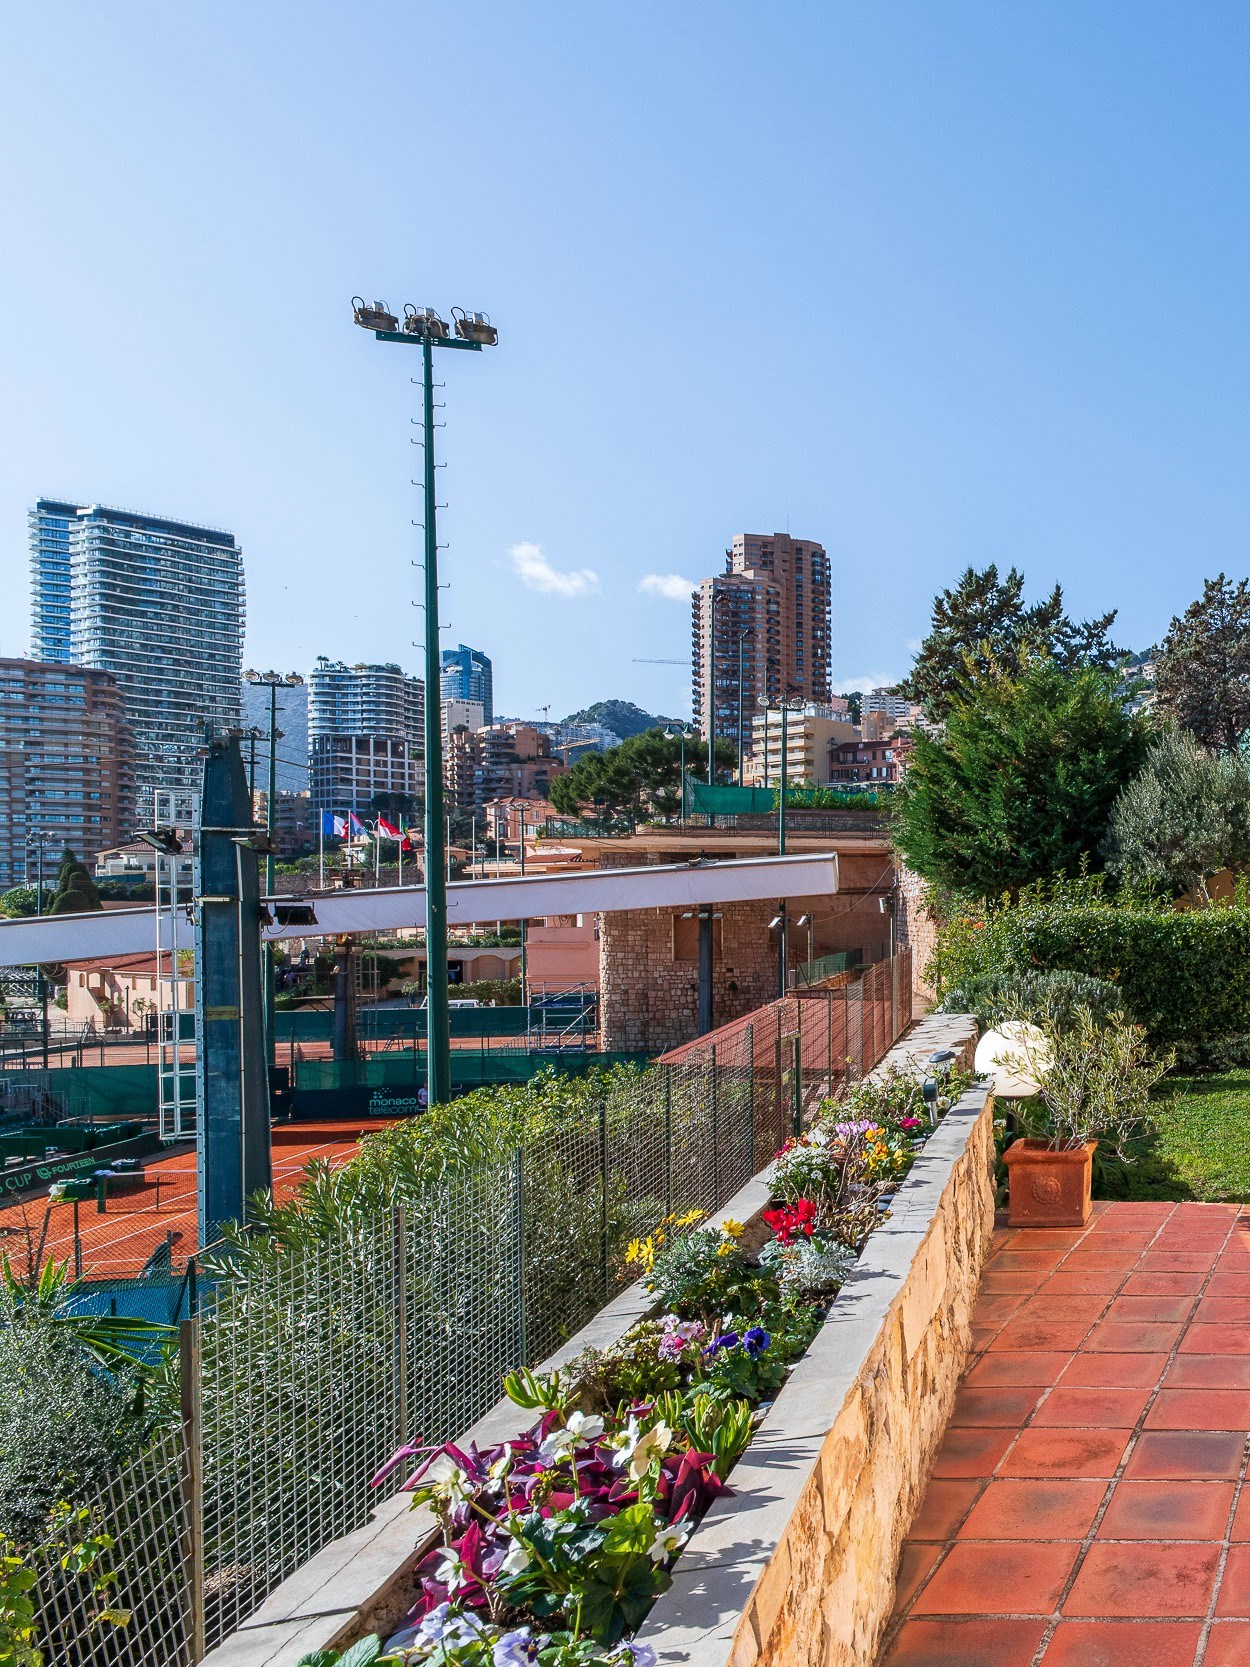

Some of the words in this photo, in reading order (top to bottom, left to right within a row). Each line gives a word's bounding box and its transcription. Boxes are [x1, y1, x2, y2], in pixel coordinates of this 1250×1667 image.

[369, 1097, 417, 1107] monaco
[369, 1105, 418, 1115] telecom
[51, 1157, 95, 1174] FOURTEEN
[5, 1173, 32, 1190] CUP
